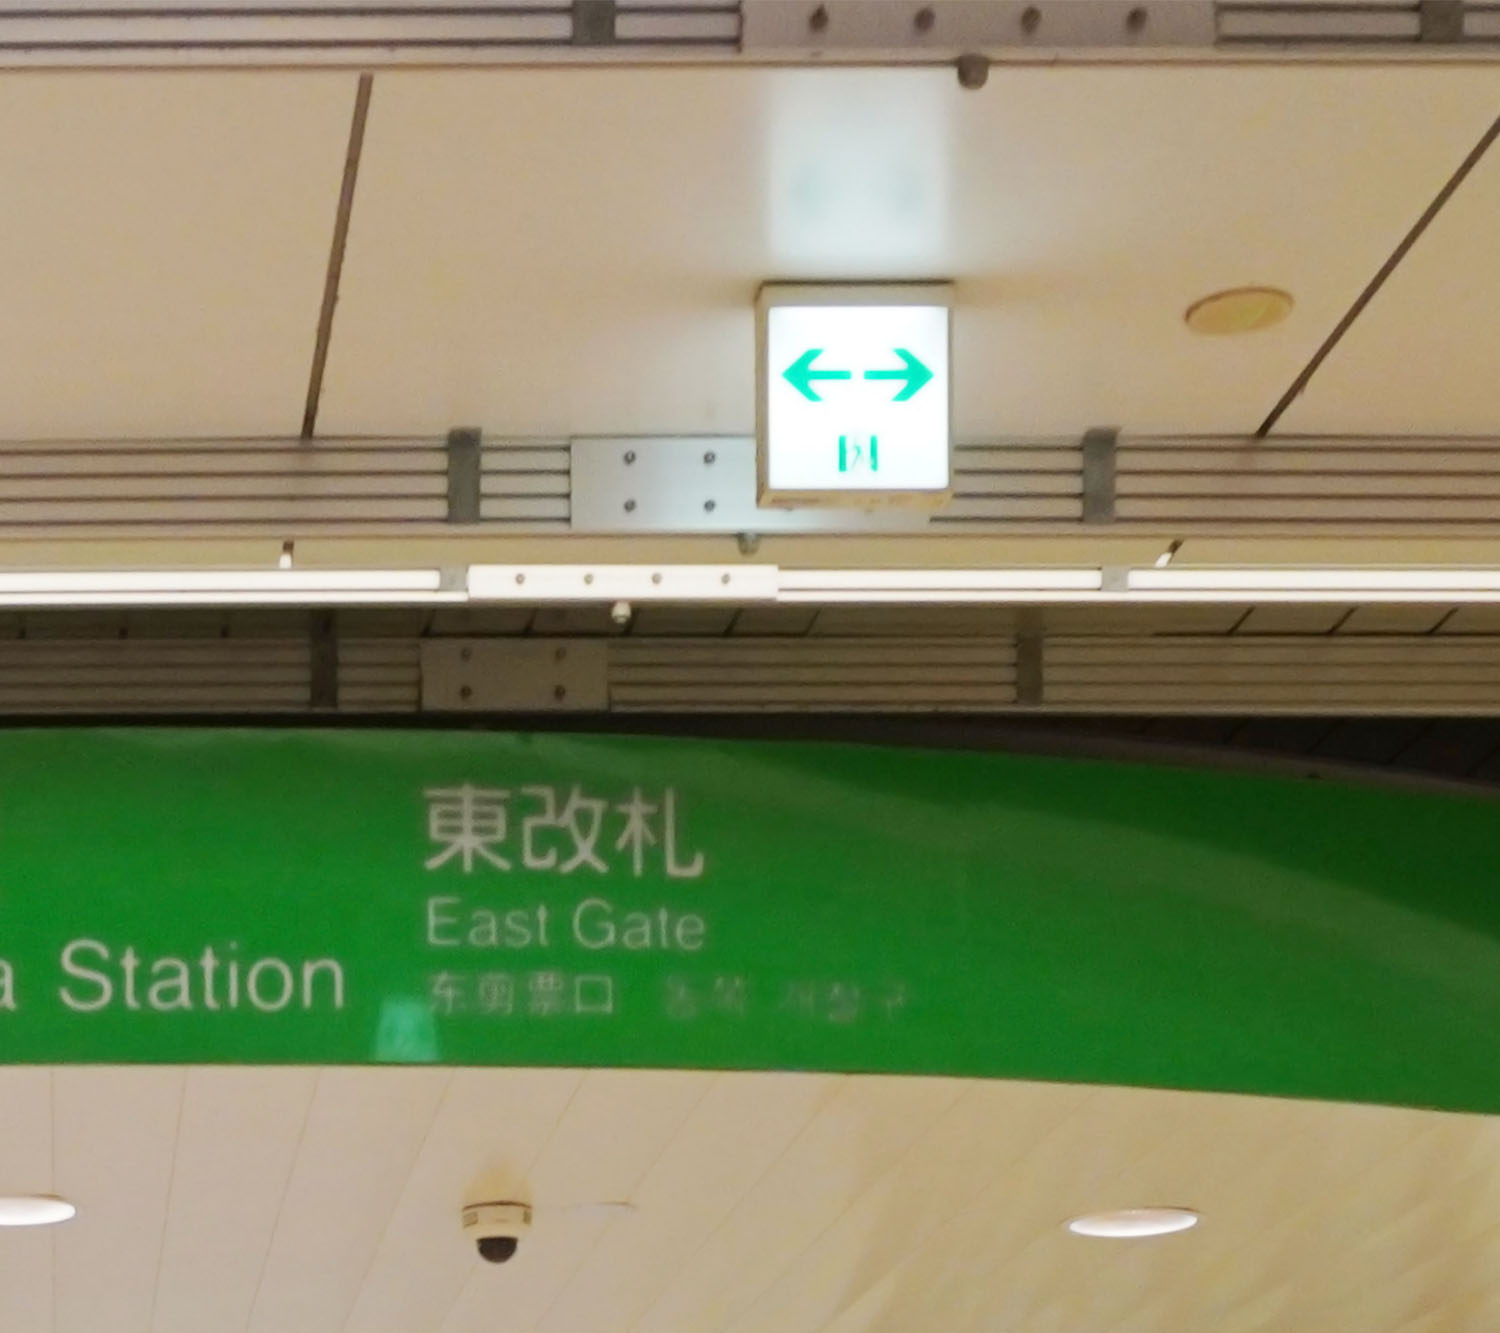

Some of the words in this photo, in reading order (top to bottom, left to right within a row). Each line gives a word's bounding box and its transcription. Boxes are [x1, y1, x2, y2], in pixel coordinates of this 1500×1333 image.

[422, 783, 705, 878] 東改札
[426, 897, 549, 947] East
[573, 898, 705, 950] Gate
[60, 939, 345, 1012] Station
